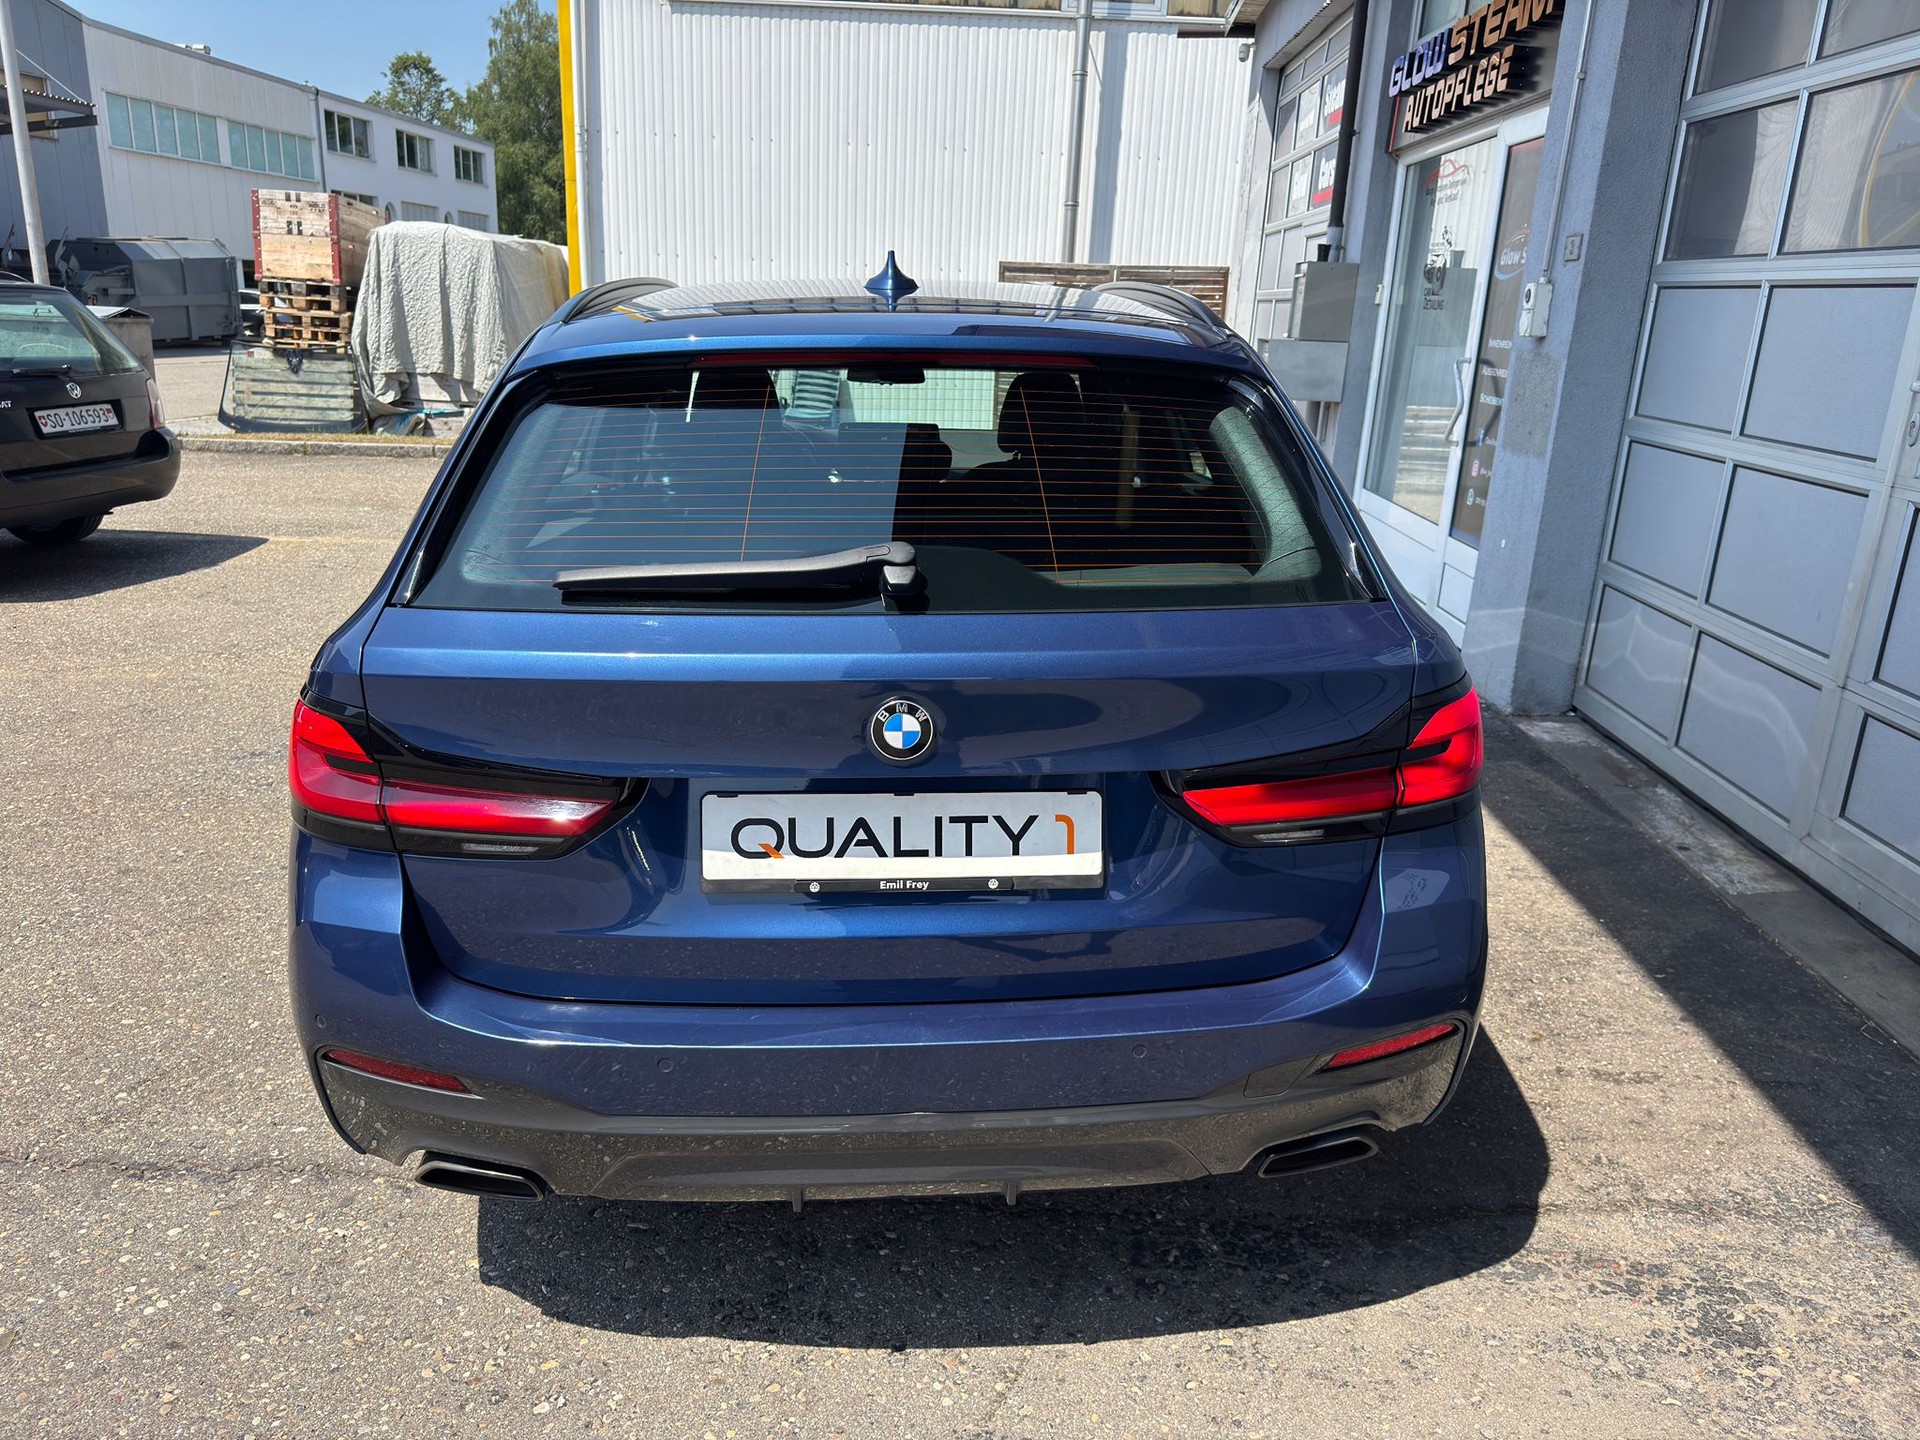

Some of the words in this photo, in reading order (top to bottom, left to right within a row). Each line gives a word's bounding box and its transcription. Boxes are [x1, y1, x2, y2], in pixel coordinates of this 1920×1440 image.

[1389, 28, 1450, 97] GLOW
[1402, 44, 1514, 132] AUTOPFLEGE
[1500, 247, 1521, 265] Glow
[0, 400, 12, 409] AT
[877, 702, 928, 722] BMW
[730, 814, 1040, 860] QUALITY
[1054, 813, 1076, 856] 1
[880, 880, 904, 890] Emil
[906, 880, 930, 891] Frey
